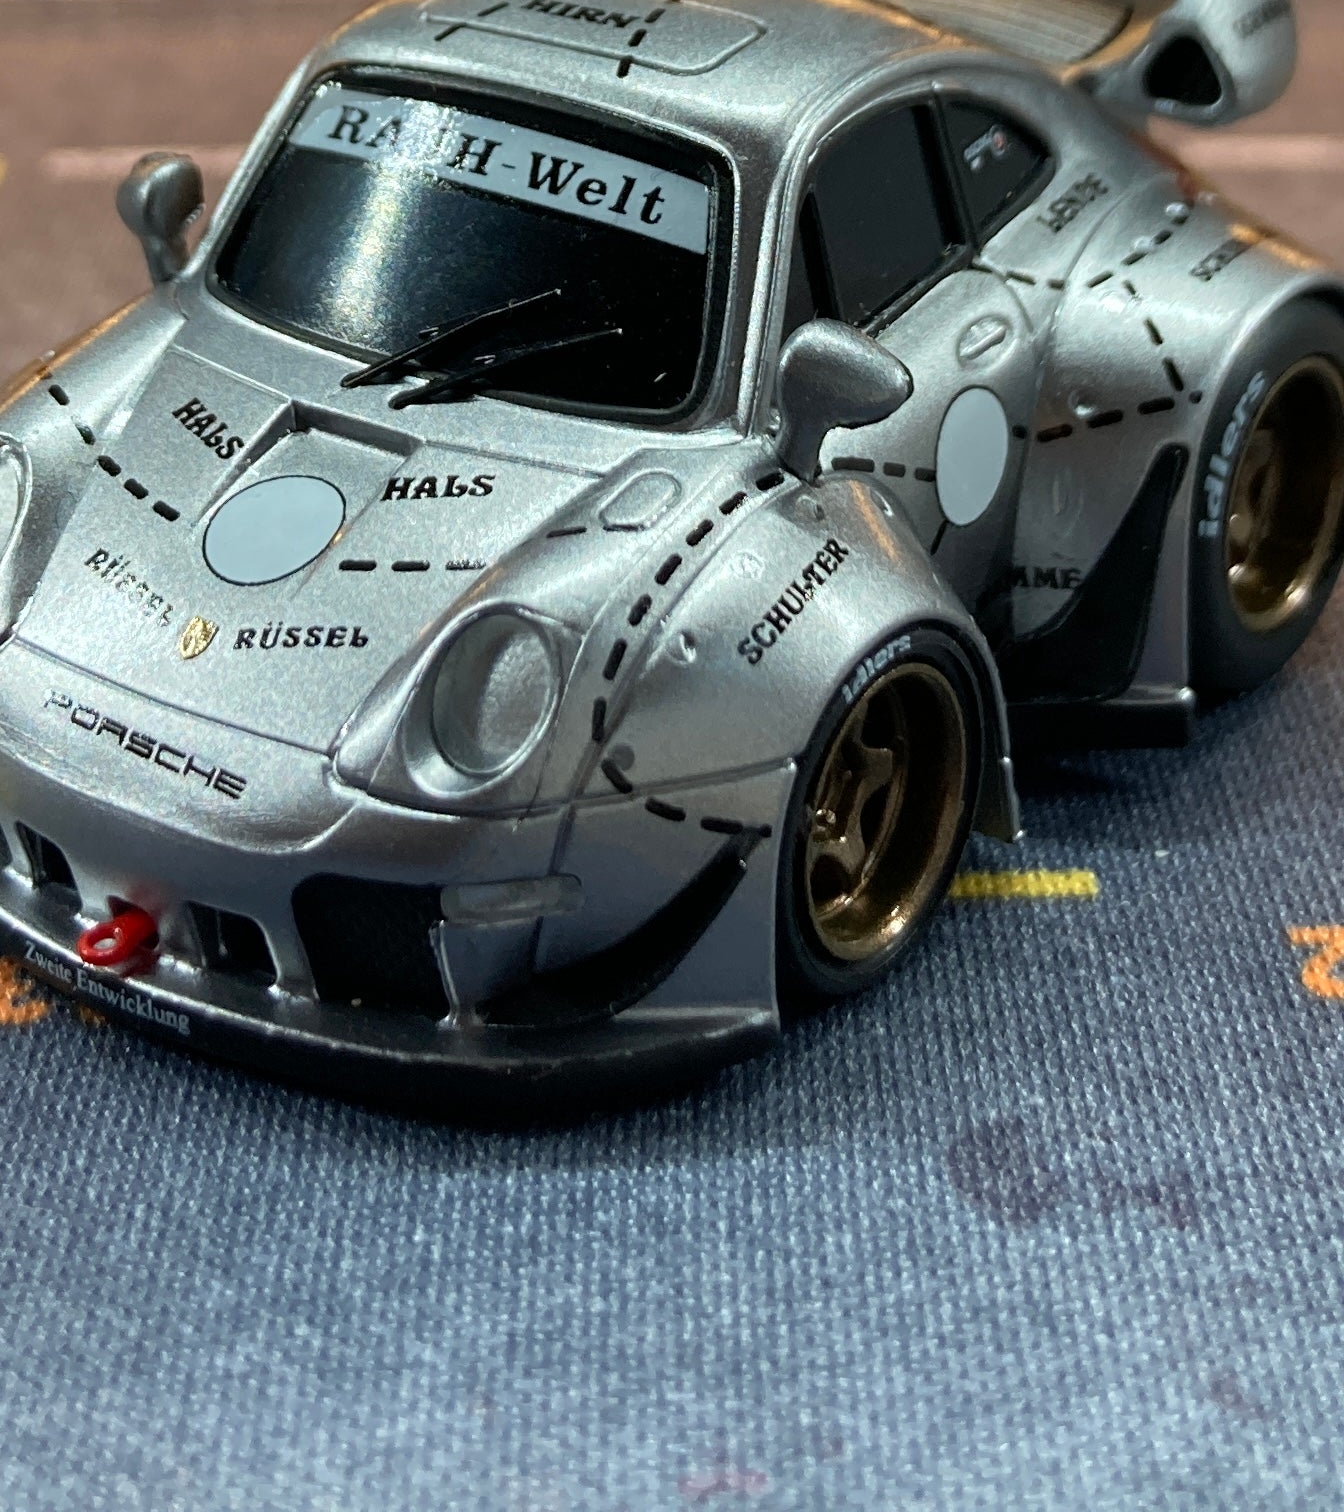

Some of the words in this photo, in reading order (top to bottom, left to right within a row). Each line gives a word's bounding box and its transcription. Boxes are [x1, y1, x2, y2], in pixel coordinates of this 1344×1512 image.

[328, 104, 666, 226] RAH-Welt
[172, 397, 245, 460] HALS
[1198, 371, 1265, 537] idlers
[380, 474, 497, 502] HALS
[232, 621, 370, 651] RÜSSEL
[737, 538, 849, 665] SCHULTER
[43, 690, 248, 799] PORSCHE
[24, 941, 74, 984] Zweite
[76, 971, 191, 1036] Entwicklung
